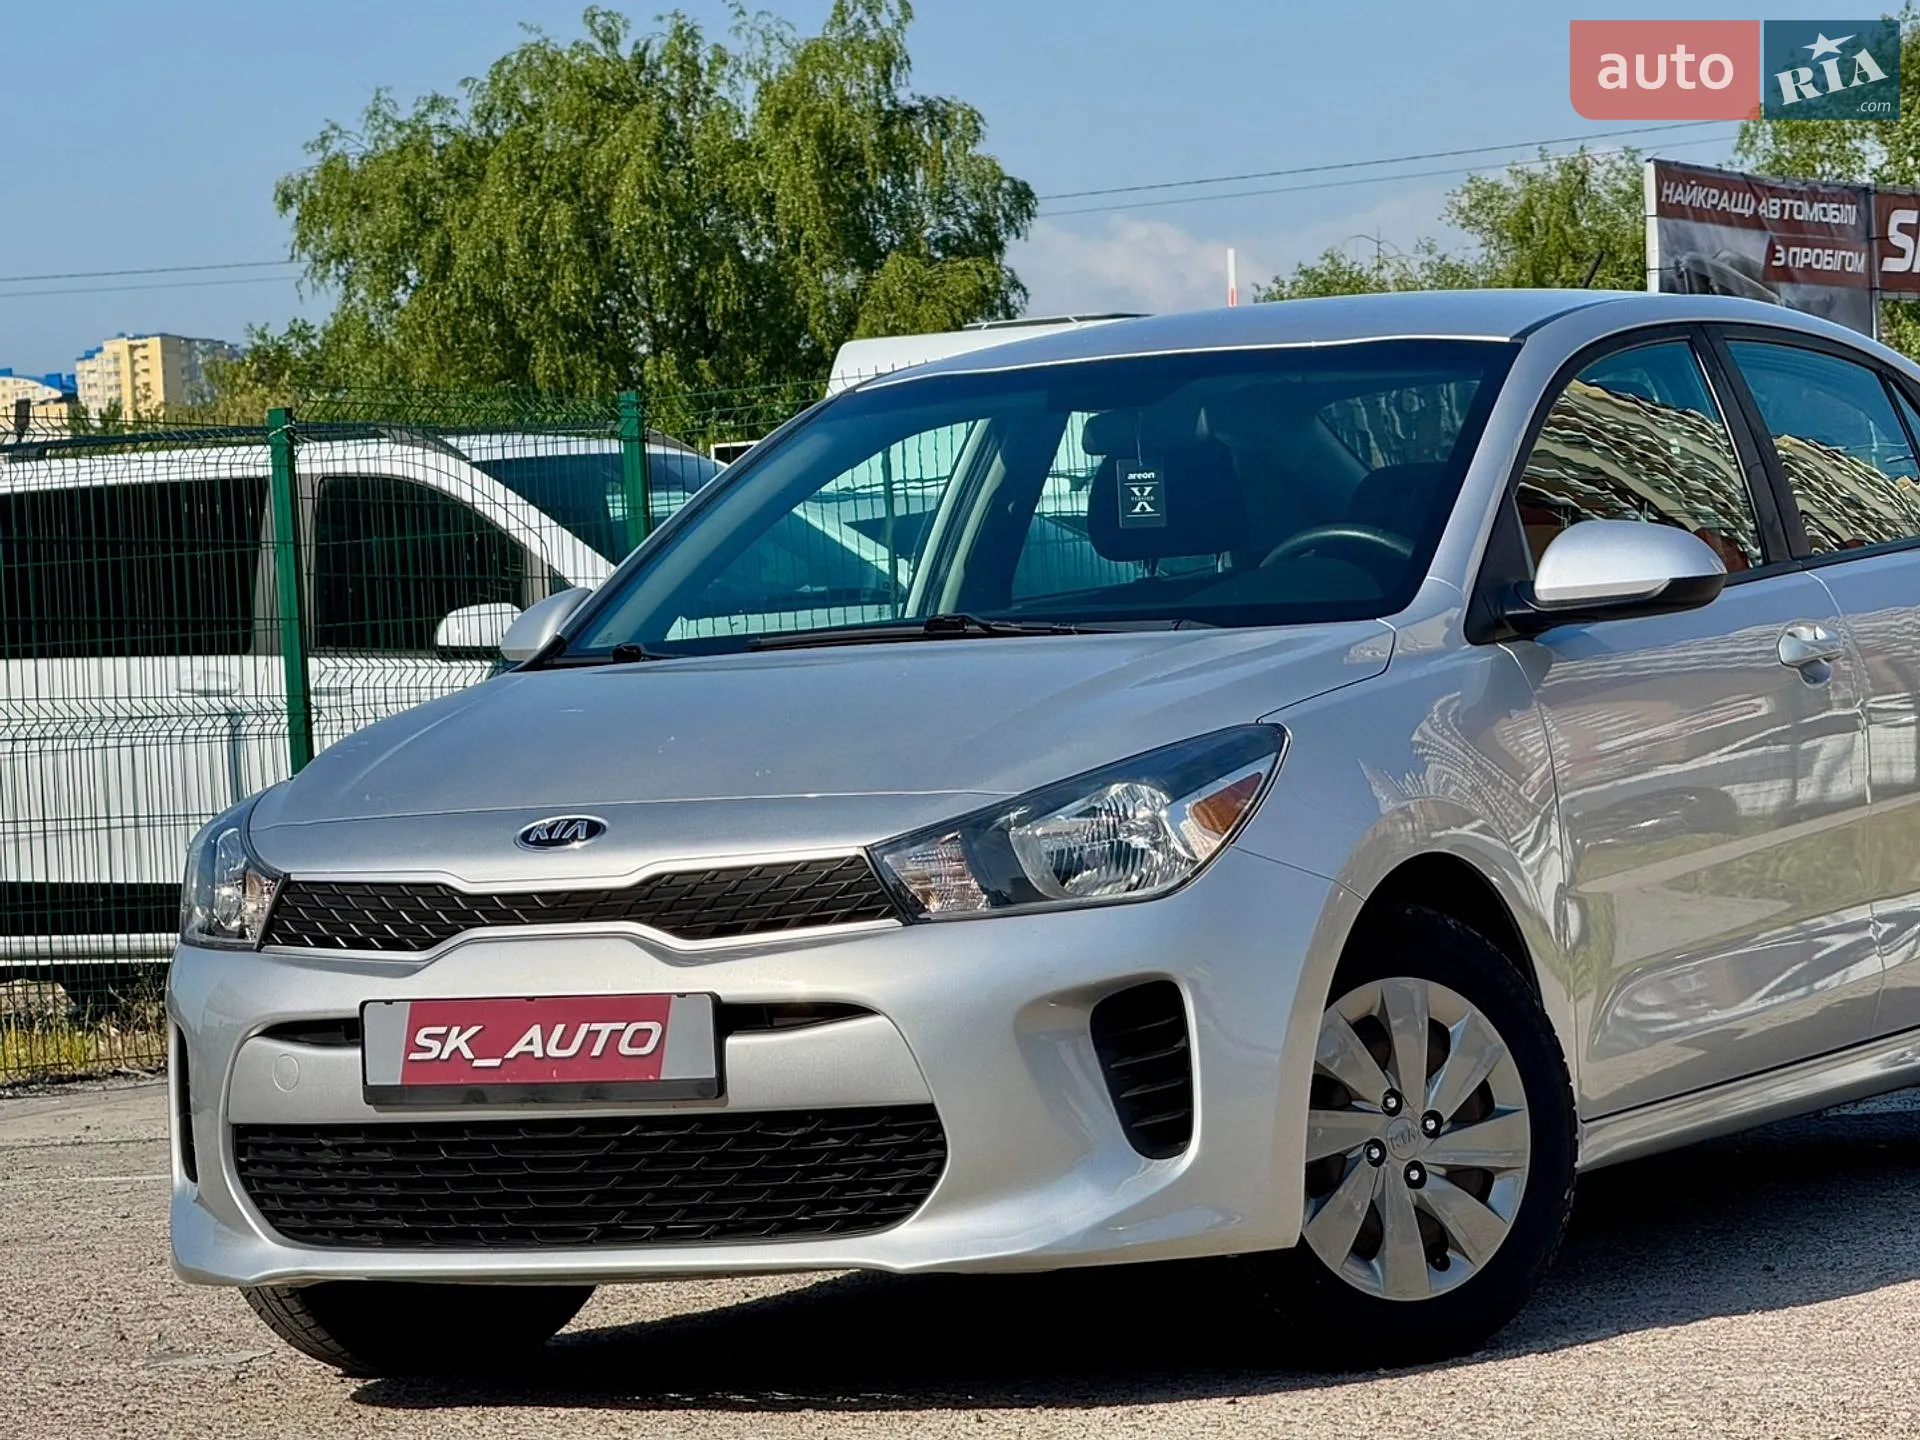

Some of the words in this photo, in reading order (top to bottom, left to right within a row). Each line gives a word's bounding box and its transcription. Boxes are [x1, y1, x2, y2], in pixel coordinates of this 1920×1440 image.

[1661, 180, 1755, 218] НАЙКРАЩІ
[1758, 198, 1857, 226] АВТОМОБІЛІ
[1771, 245, 1786, 267] З
[1788, 247, 1866, 273] ПРОБІГОМ
[1881, 209, 1920, 273] S
[529, 820, 587, 842] KIA
[408, 1021, 663, 1067] SK_AUTO
